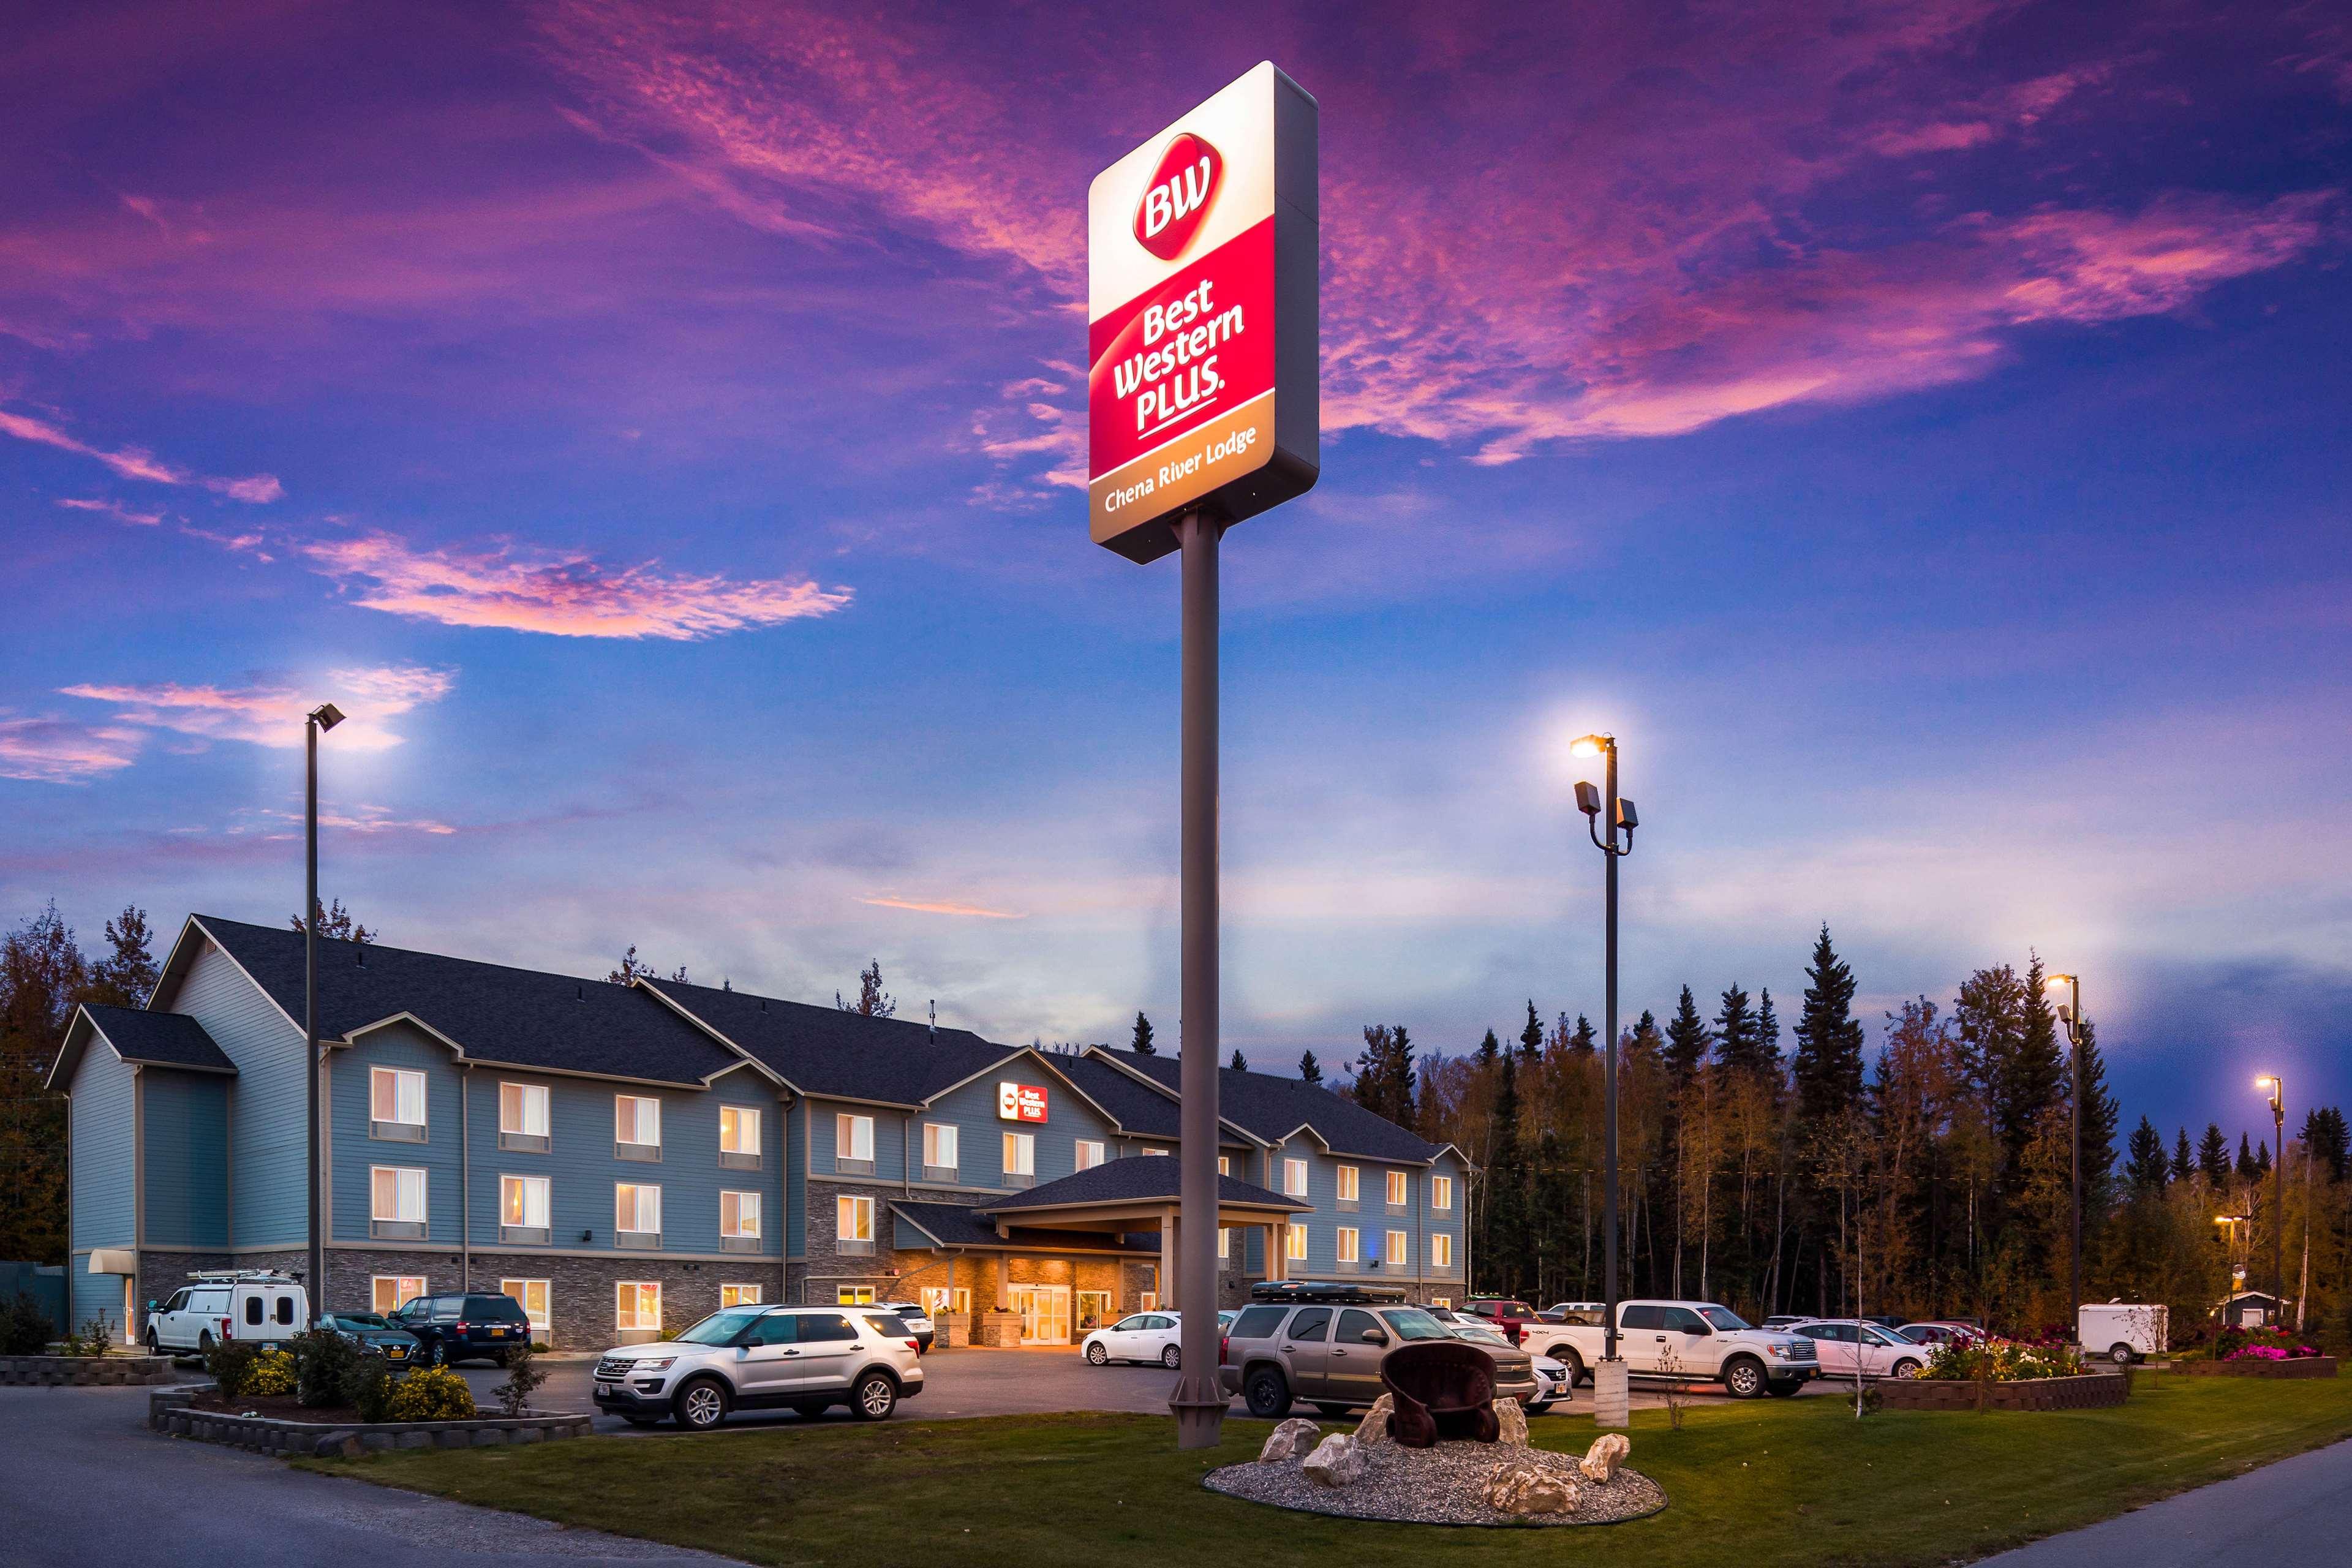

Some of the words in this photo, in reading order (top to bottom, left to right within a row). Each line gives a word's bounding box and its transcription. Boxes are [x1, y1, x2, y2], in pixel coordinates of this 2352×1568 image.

[1146, 156, 1211, 238] BW
[1114, 304, 1245, 400] Western
[1144, 279, 1215, 347] Best
[1105, 477, 1155, 513] Chena
[1159, 451, 1202, 488] River
[1207, 426, 1256, 464] Lodge
